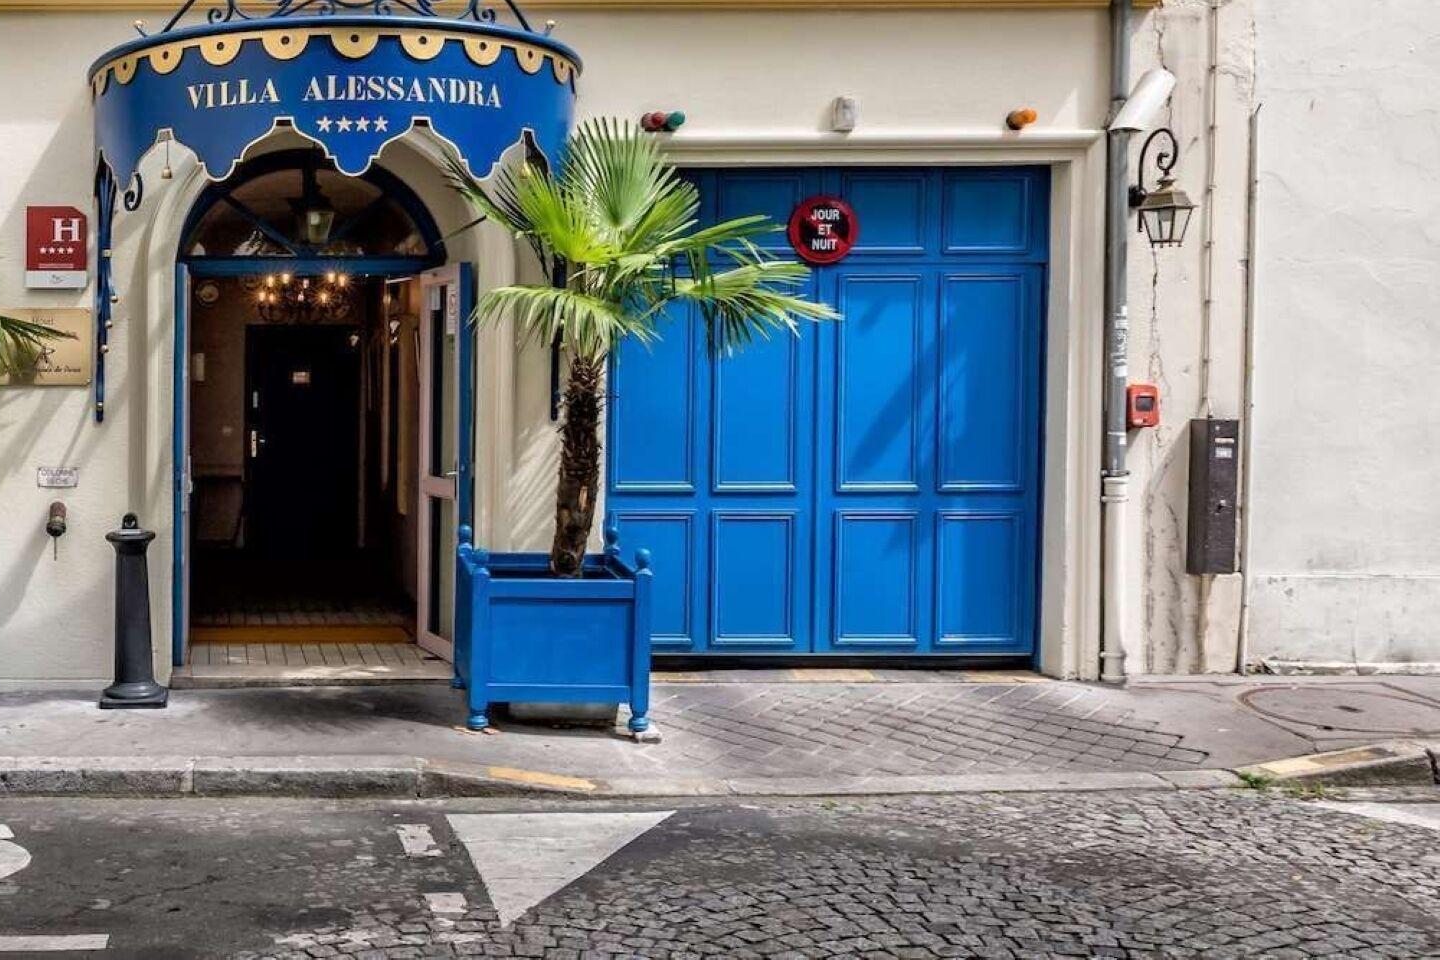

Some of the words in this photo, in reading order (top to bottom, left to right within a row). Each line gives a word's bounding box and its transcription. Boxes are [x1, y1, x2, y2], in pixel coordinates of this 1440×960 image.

[186, 77, 280, 110] VILLA
[302, 74, 503, 109] ALESSANDRA
[811, 209, 840, 220] JOUR
[51, 217, 81, 242] H
[818, 224, 832, 235] ET
[811, 239, 838, 251] NUIT
